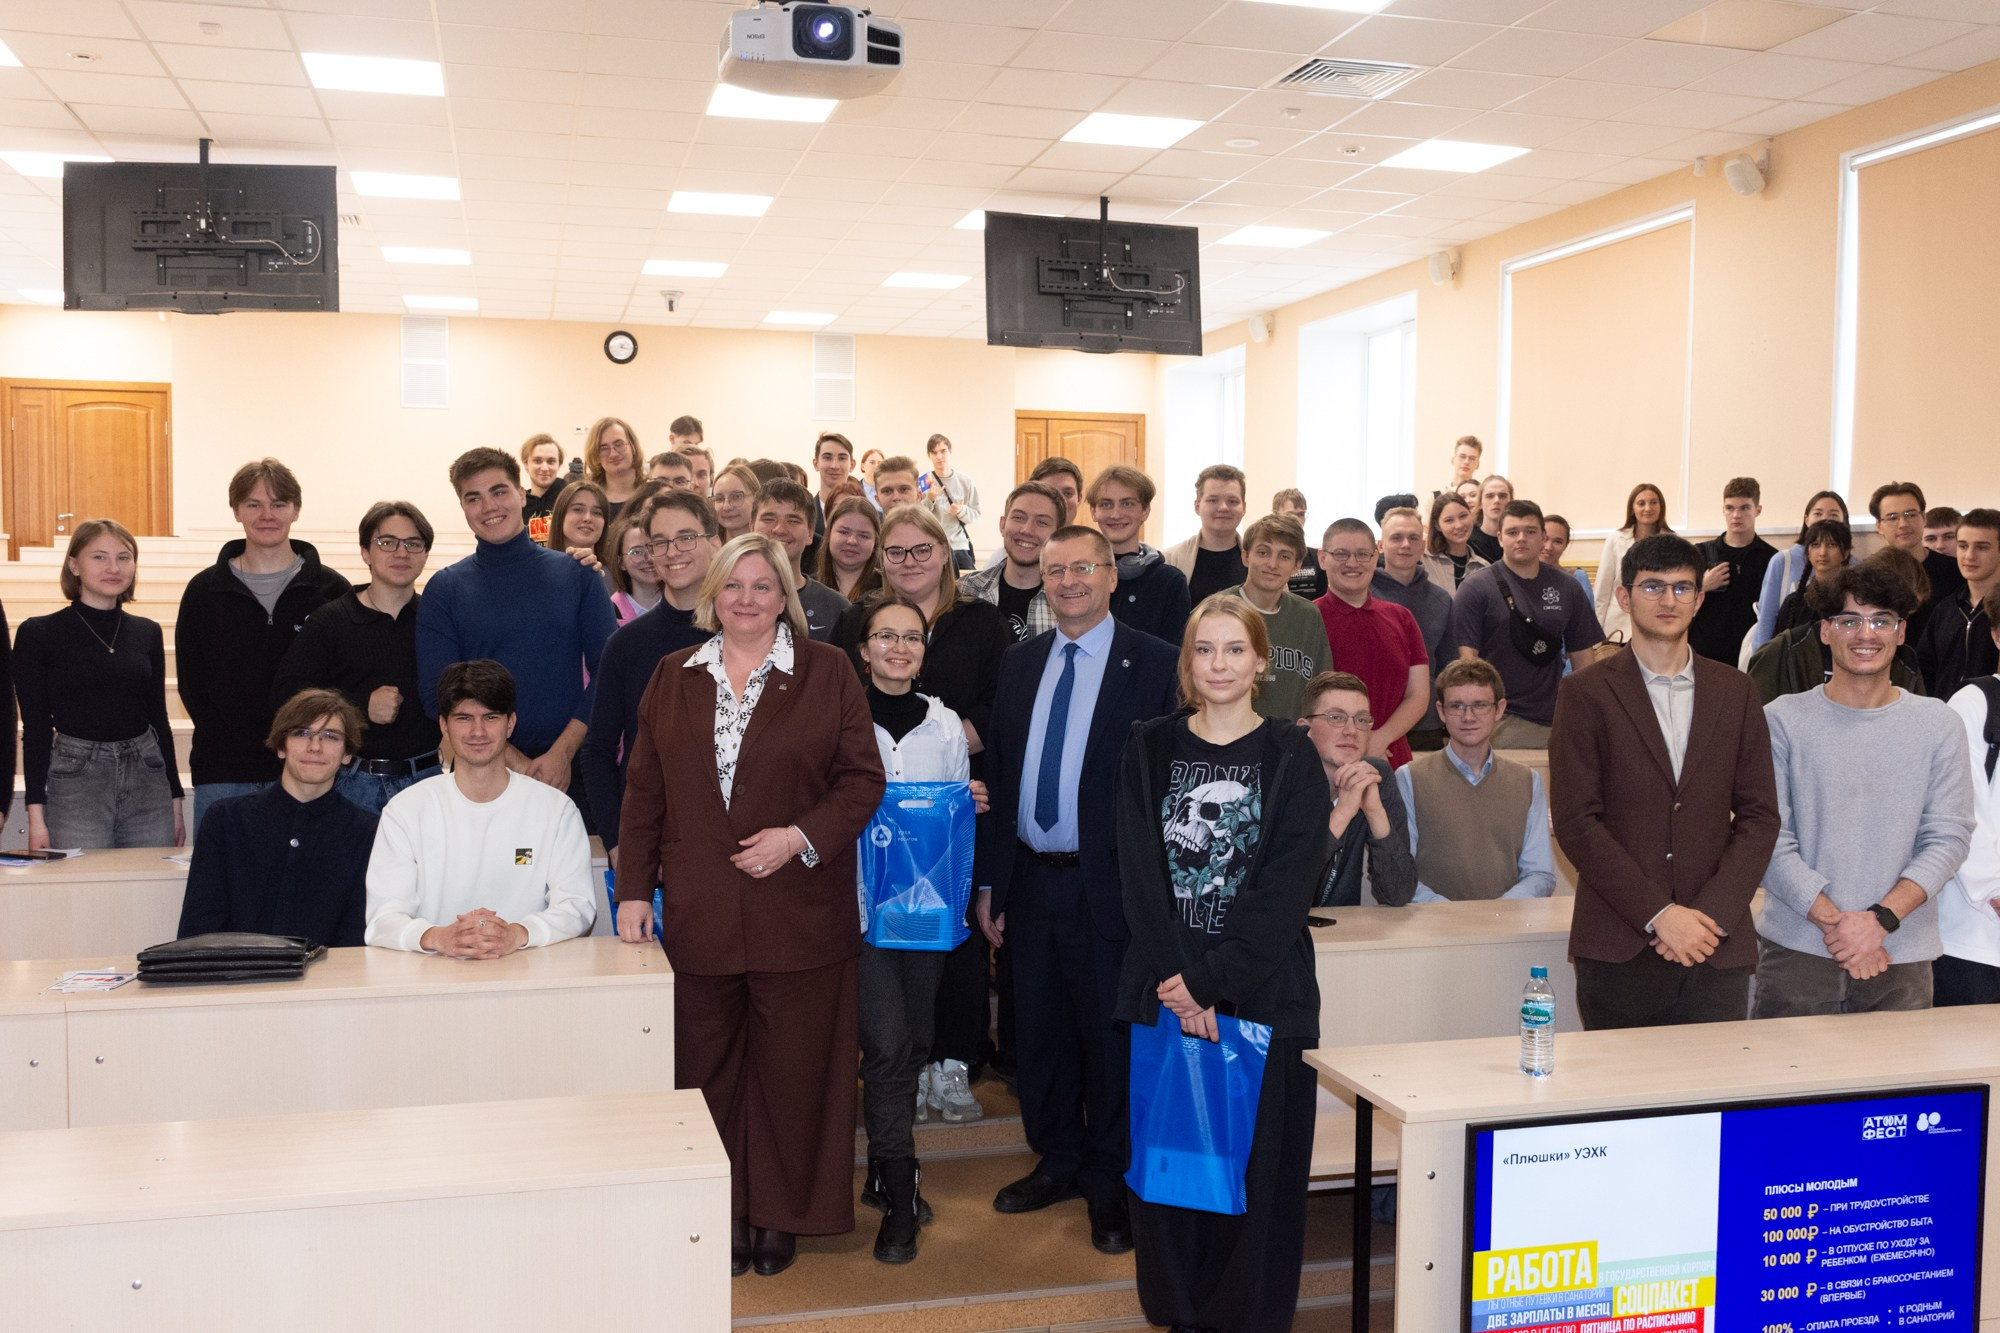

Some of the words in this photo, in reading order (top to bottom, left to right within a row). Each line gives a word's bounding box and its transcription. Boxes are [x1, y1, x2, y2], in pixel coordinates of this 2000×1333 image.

[1863, 1126, 1907, 1140] ФЕСТ
[1503, 1152, 1570, 1165] «Плюшки»
[1574, 1145, 1608, 1159] УЭХК
[1765, 1182, 1804, 1196] ПЛЮСЫ
[1806, 1178, 1858, 1192] МОЛОДЫМ
[1763, 1208, 1778, 1221] 50
[1780, 1206, 1802, 1219] 000
[1830, 1202, 1848, 1212] ПРИ
[1849, 1194, 1930, 1211] ТРУДОУСТРОЙСТВЕ
[1762, 1230, 1784, 1243] 100
[1829, 1226, 1842, 1235] НА
[1842, 1218, 1909, 1234] ОБУСТРОЙСТВО
[1910, 1217, 1933, 1227] БЫТА
[1762, 1255, 1777, 1267] 10
[1779, 1252, 1801, 1266] 000
[1828, 1246, 1834, 1255] В
[1835, 1241, 1875, 1254] ОТПУСКЕ
[1876, 1240, 1889, 1250] ПО
[1890, 1237, 1918, 1249] УХОДУ
[1918, 1236, 1930, 1246] ЗА
[1821, 1255, 1867, 1268] РЕБЕНКОМ
[1870, 1247, 1935, 1264] (ЕЖЕМЕСЯЧНО)
[1487, 1247, 1593, 1294] РАБОТА
[1598, 1271, 1604, 1283] В
[1605, 1261, 1680, 1282] ГОСУДАРСТВЕННОЙ
[1760, 1289, 1775, 1302] 30
[1777, 1286, 1799, 1300] 000
[1827, 1281, 1833, 1290] В
[1834, 1278, 1863, 1290] СВЯЗИ
[1864, 1277, 1871, 1286] С
[1872, 1268, 1954, 1286] БРАКОСОЧЕТАНИЕМ
[1487, 1296, 1525, 1311] ЛЬГОТНЫЕ
[1559, 1292, 1564, 1302] В
[1617, 1278, 1700, 1316] СОЦПАКЕТ
[1819, 1291, 1866, 1304] (ВПЕРВЫЕ)
[1899, 1304, 1905, 1314] К
[1906, 1301, 1942, 1314] РОДНЫМ
[1486, 1313, 1508, 1330] ДВЕ
[1510, 1307, 1565, 1325] ЗАРПЛАТЫ
[1567, 1306, 1574, 1319] В
[1576, 1302, 1610, 1318] МЕСЯЦ
[1580, 1319, 1621, 1333] ПЯТНИЦА
[1623, 1317, 1635, 1331] ПО
[1636, 1311, 1696, 1329] РАСПИСАНИЮ
[1762, 1322, 1794, 1333] 100%
[1806, 1319, 1840, 1332] ОПЛАТА
[1841, 1315, 1880, 1327] ПРОЕЗДА
[1899, 1317, 1905, 1326] В
[1905, 1310, 1955, 1325] САНАТОРИЙ
